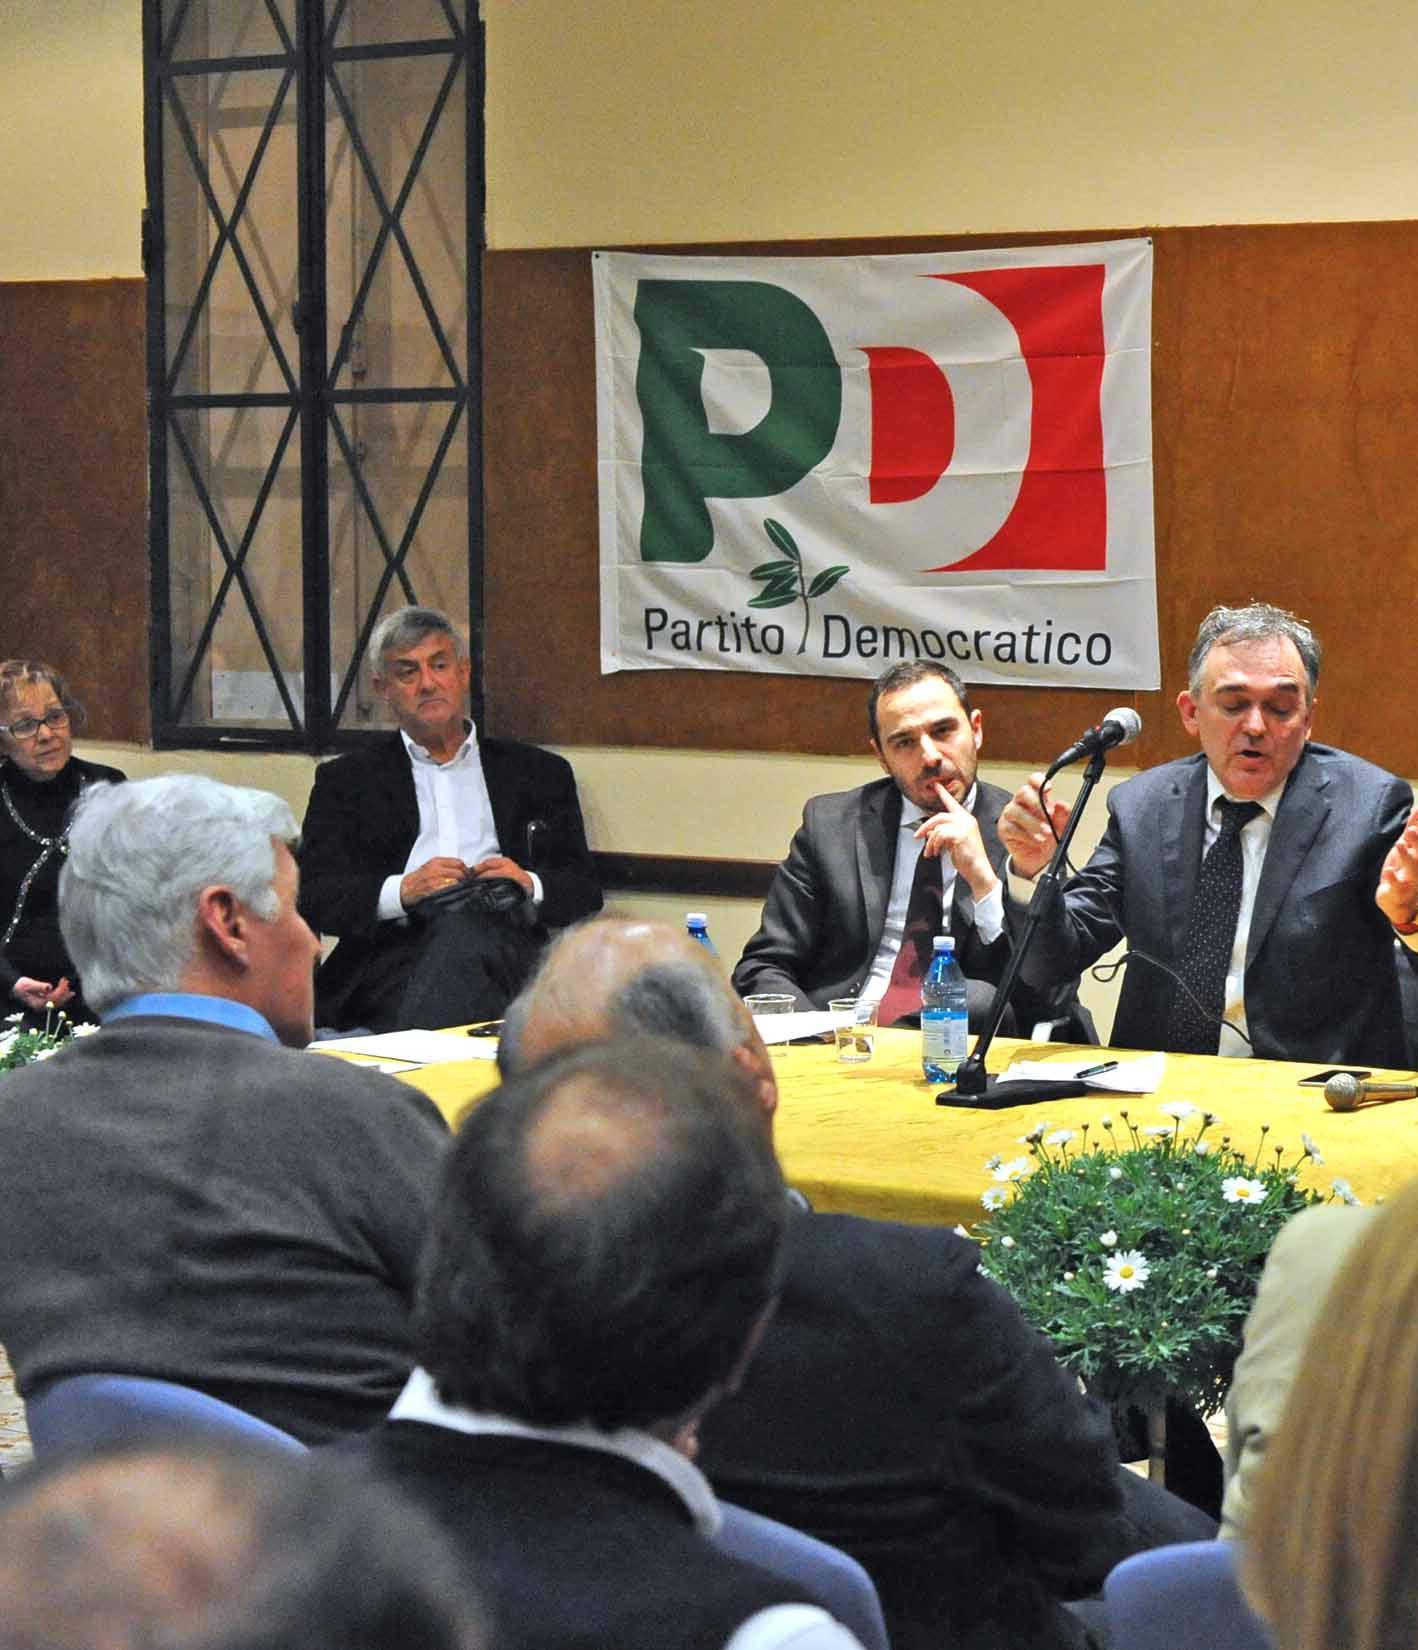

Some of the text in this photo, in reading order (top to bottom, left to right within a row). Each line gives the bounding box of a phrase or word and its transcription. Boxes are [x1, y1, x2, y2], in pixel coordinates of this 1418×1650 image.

[634, 264, 1106, 572] PD
[644, 607, 1112, 666] Partito Democratico
